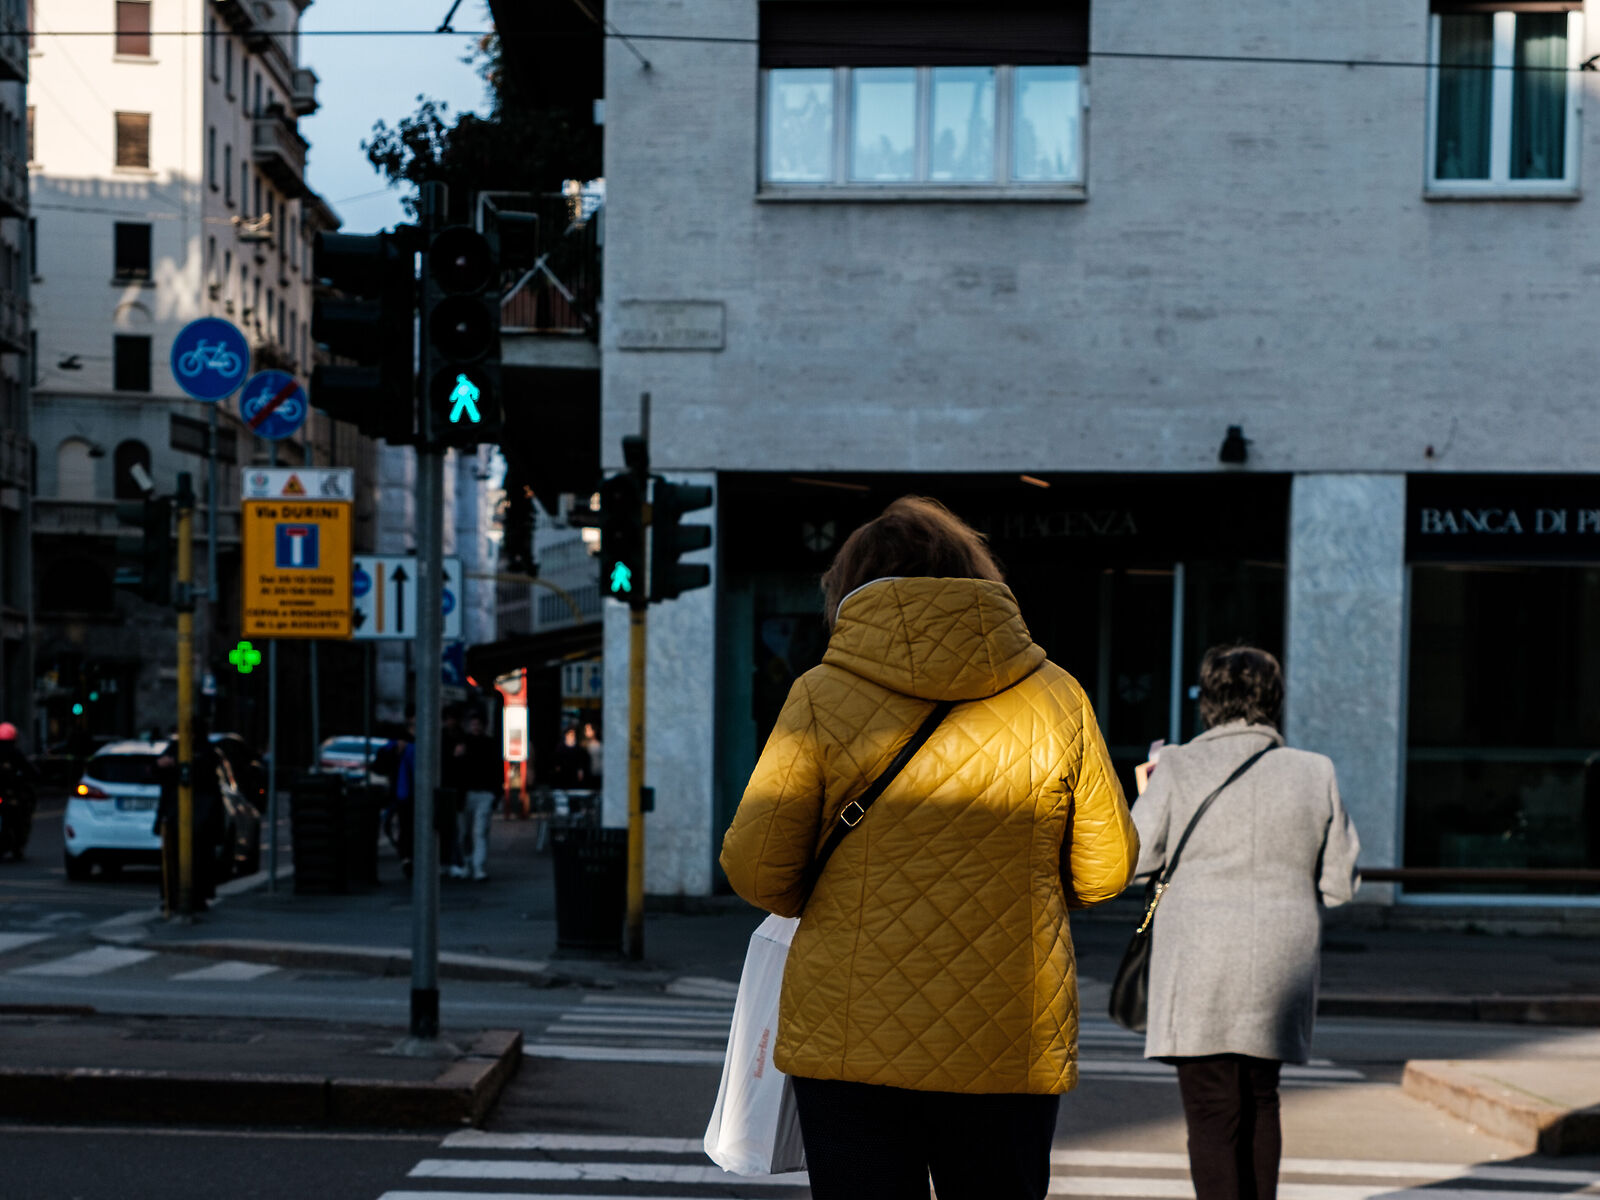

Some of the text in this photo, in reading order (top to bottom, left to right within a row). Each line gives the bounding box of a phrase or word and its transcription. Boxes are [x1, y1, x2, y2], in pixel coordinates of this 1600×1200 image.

[282, 506, 339, 519] DURINI
[1004, 511, 1140, 538] PIACENZA
[1420, 509, 1523, 534] BANCA
[1535, 509, 1567, 534] DI
